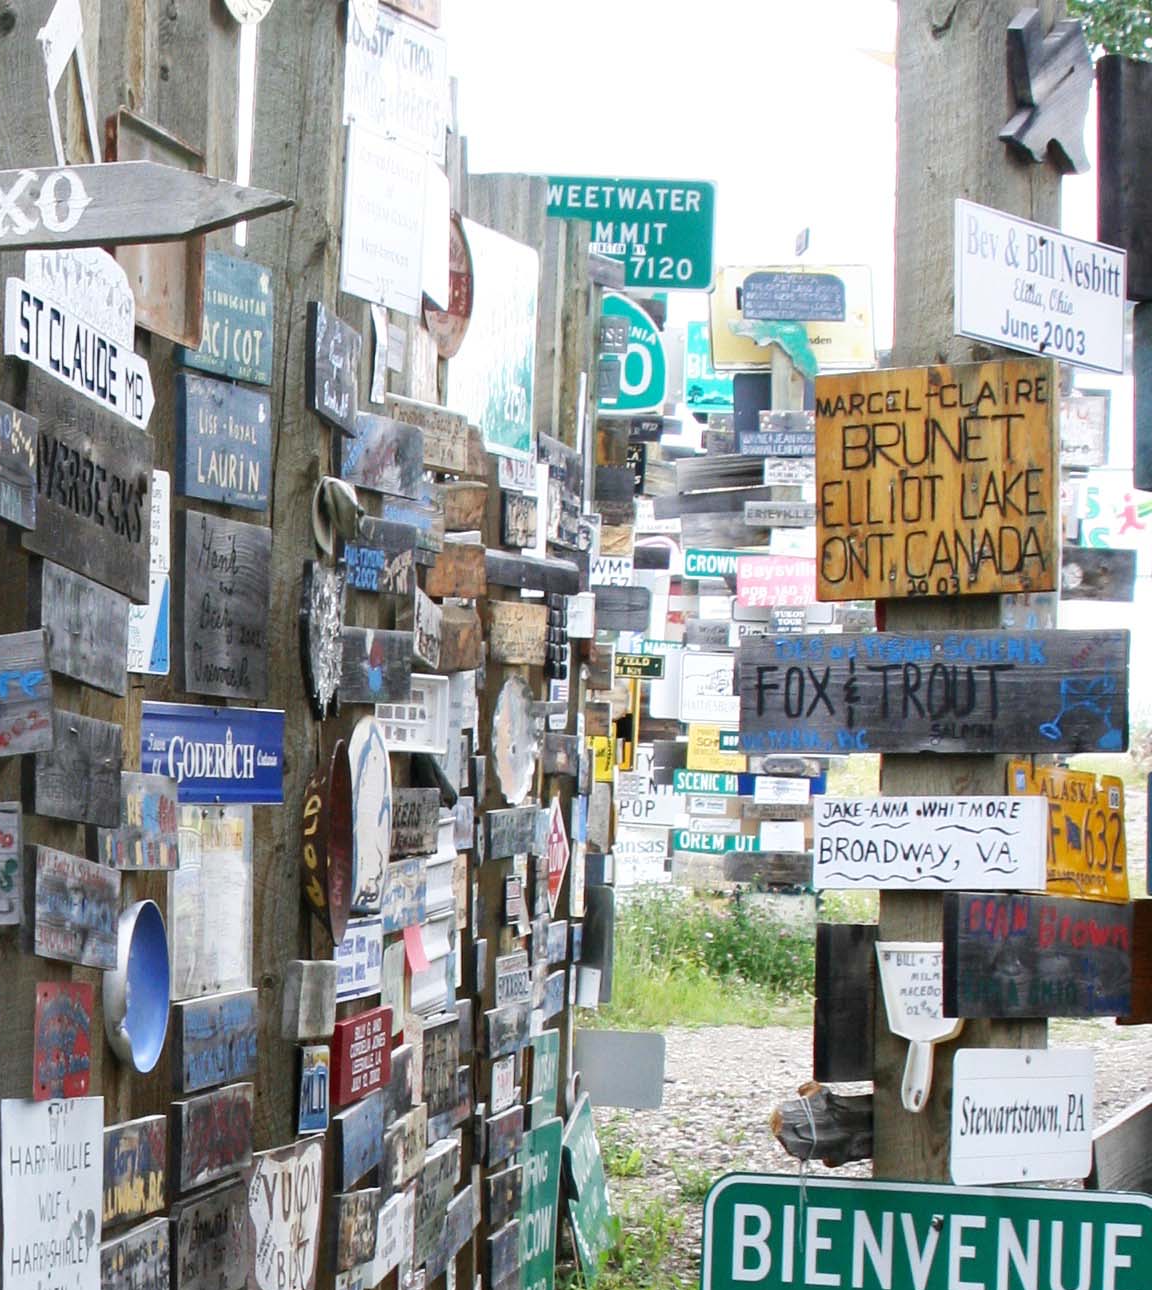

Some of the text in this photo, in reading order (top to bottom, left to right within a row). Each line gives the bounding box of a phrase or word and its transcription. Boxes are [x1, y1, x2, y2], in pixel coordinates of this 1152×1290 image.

[546, 185, 702, 212] WEETWATER
[629, 256, 694, 281] 7120
[965, 215, 1122, 299] Bev Bill Nesbitt
[20, 290, 44, 359] ST
[47, 306, 118, 406] CLAUDE
[124, 366, 144, 422] MB
[1000, 310, 1087, 357] June 2003
[816, 387, 922, 419] MARCEL
[841, 413, 1026, 472] BRUNET
[961, 468, 1047, 521] LAKE
[686, 553, 738, 575] CROWN
[904, 526, 1049, 580] CANADA
[754, 662, 1016, 720] FOX TROUT
[677, 772, 721, 791] SCENIC
[618, 799, 656, 818] POP
[921, 800, 1021, 820] WHITMORE
[679, 830, 757, 853] OREM UT
[817, 837, 1019, 873] BROADWAY, VA.
[1084, 811, 1123, 873] 632
[1038, 903, 1130, 951] Brown
[959, 1093, 1086, 1138] Stewartstown, PA
